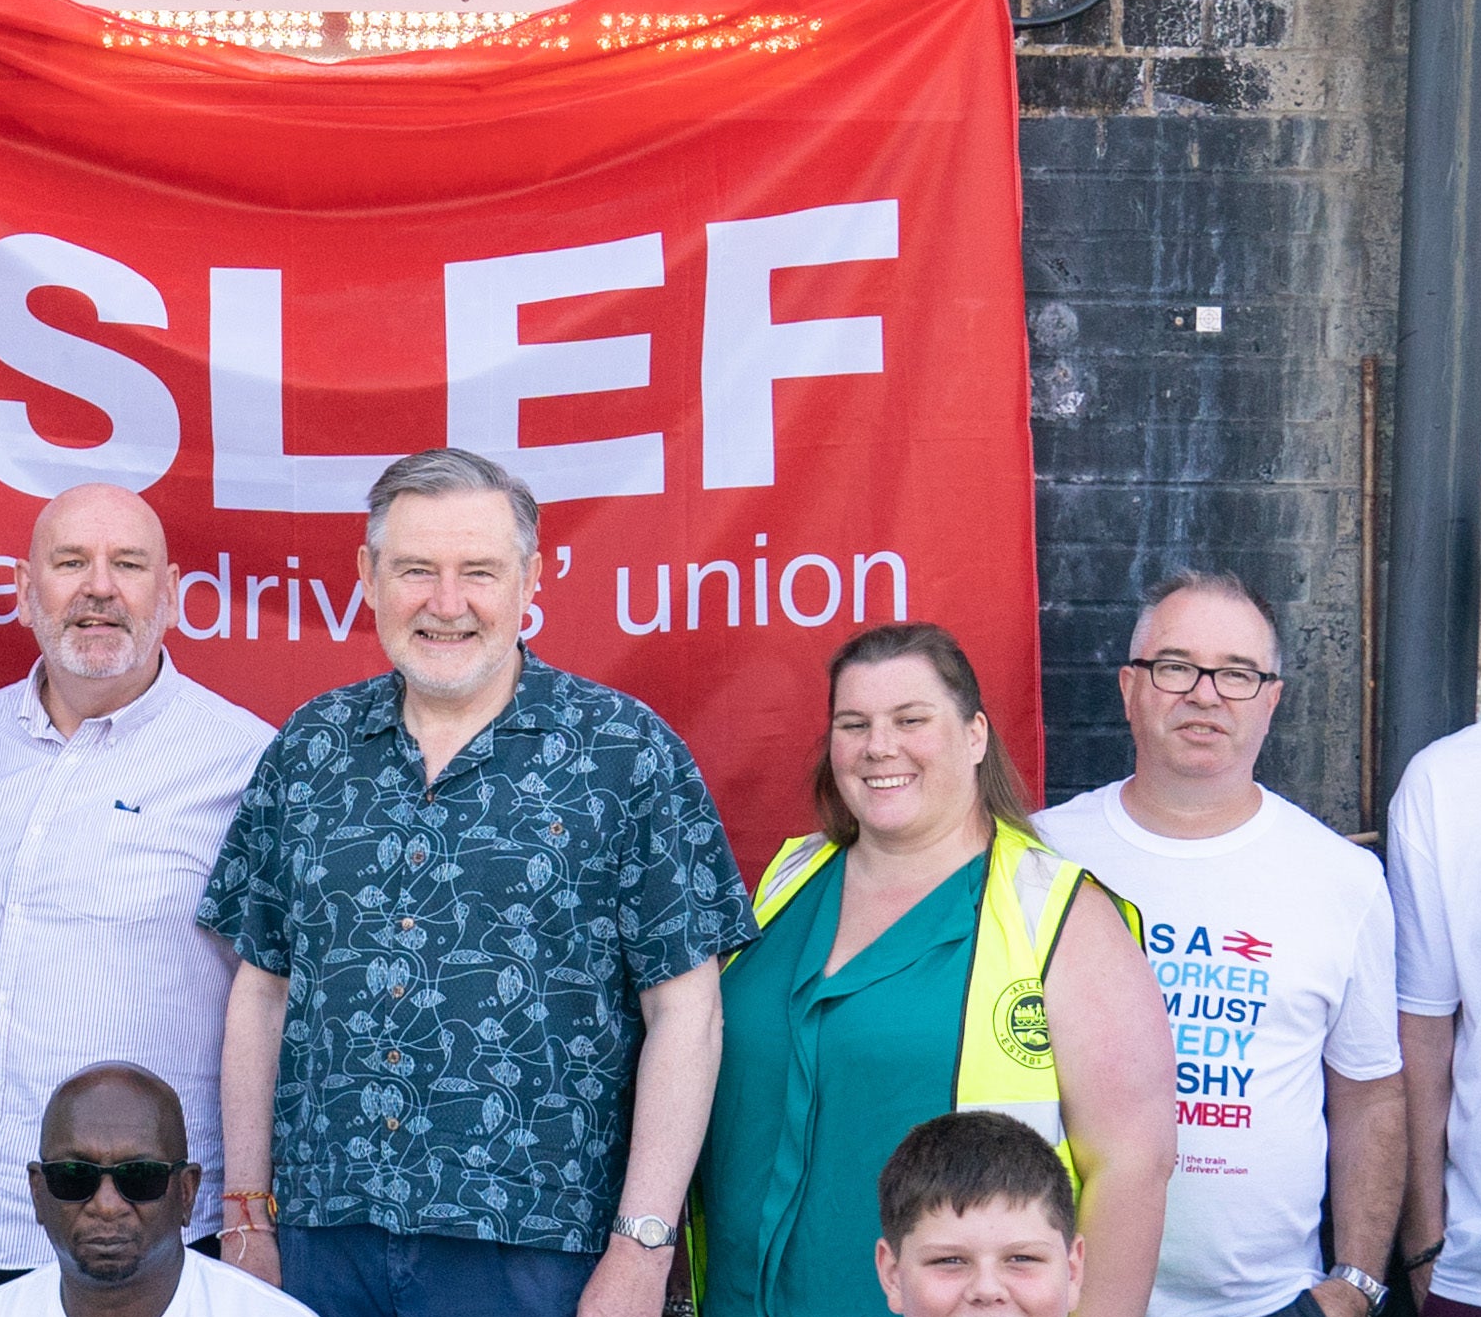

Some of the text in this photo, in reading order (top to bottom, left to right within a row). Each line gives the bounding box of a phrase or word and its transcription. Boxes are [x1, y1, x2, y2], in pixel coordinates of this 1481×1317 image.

[616, 533, 907, 635] union
[1185, 926, 1212, 956] A
[1188, 994, 1266, 1025] JUST
[1187, 1156, 1226, 1165] the train
